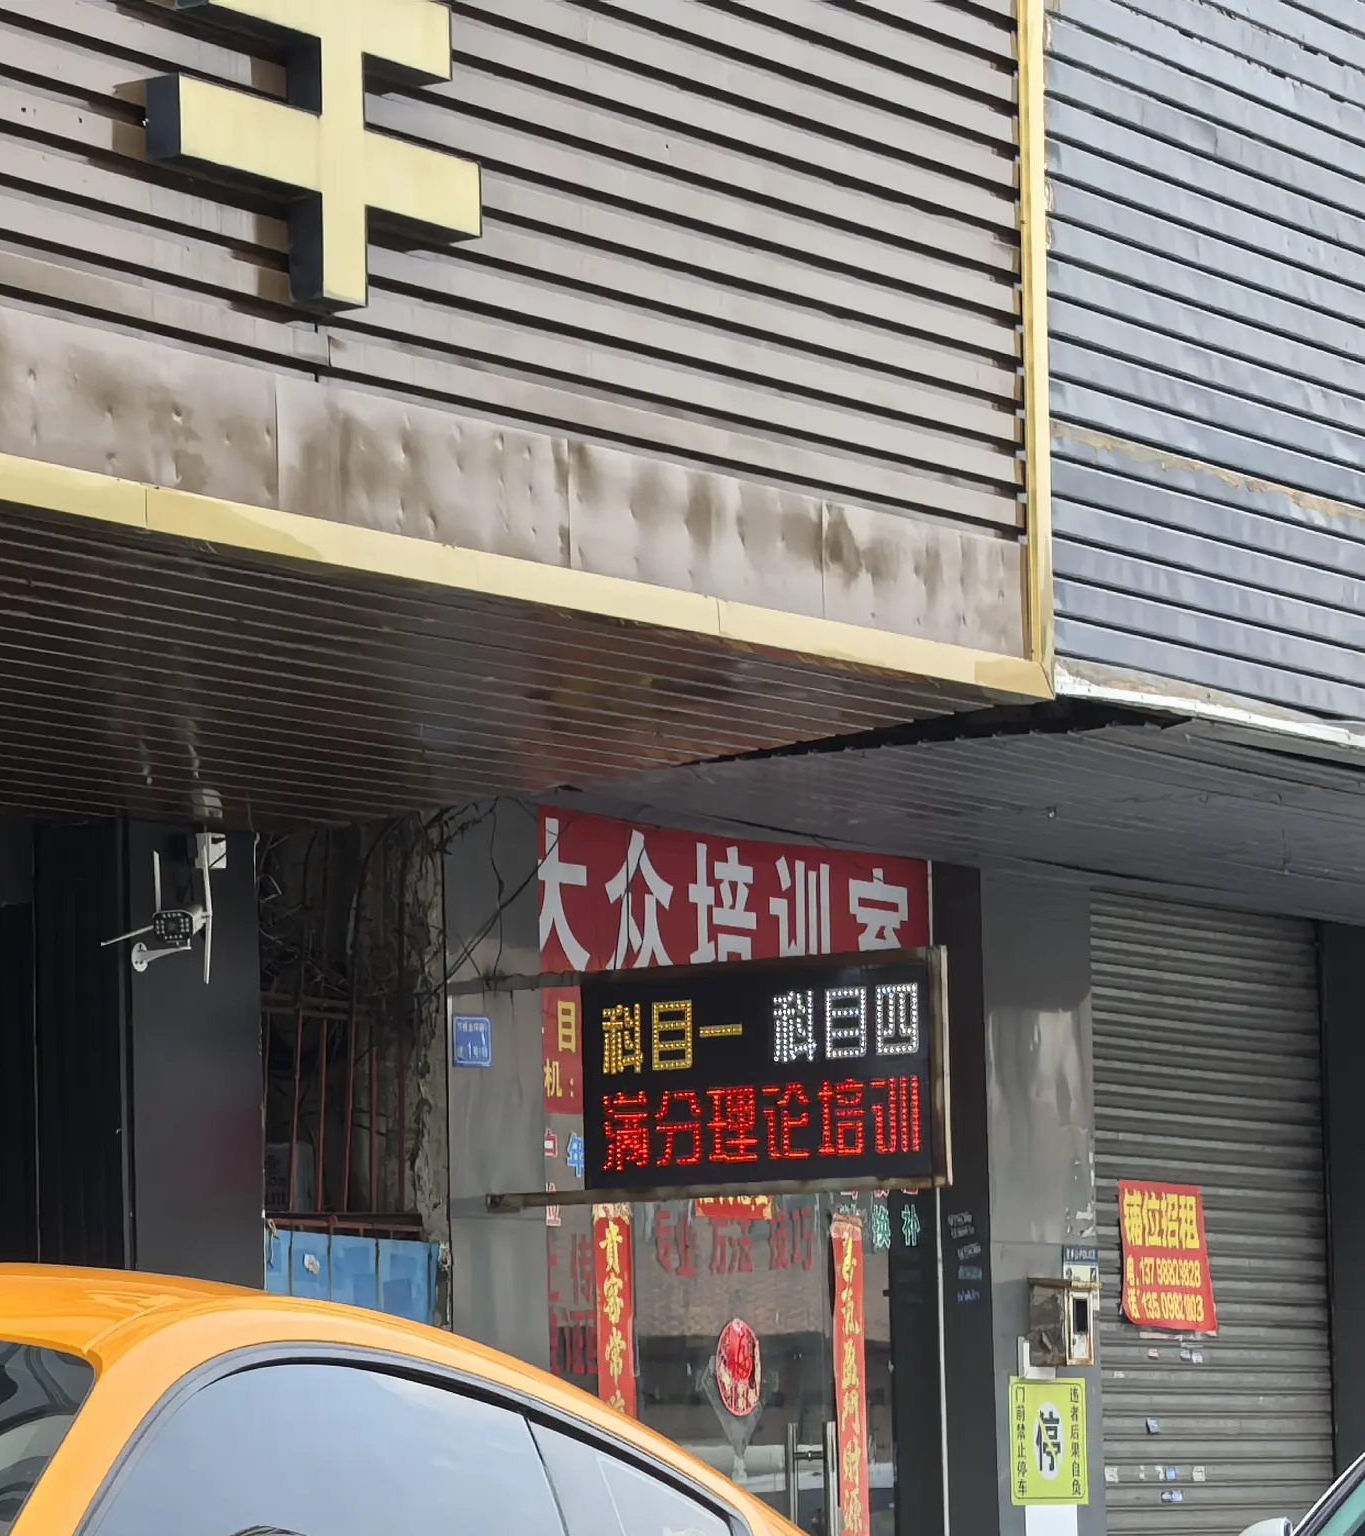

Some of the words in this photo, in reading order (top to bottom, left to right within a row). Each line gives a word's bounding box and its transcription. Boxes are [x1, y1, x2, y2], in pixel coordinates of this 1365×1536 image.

[537, 817, 909, 972] 大众培训室
[602, 998, 743, 1075] 科目一
[772, 982, 919, 1064] 科目四
[601, 1075, 921, 1172] 满分理论培训
[1015, 1386, 1028, 1496] 门前禁止停车
[1036, 1410, 1061, 1472] 停
[1069, 1386, 1082, 1496] 违者后果自负
